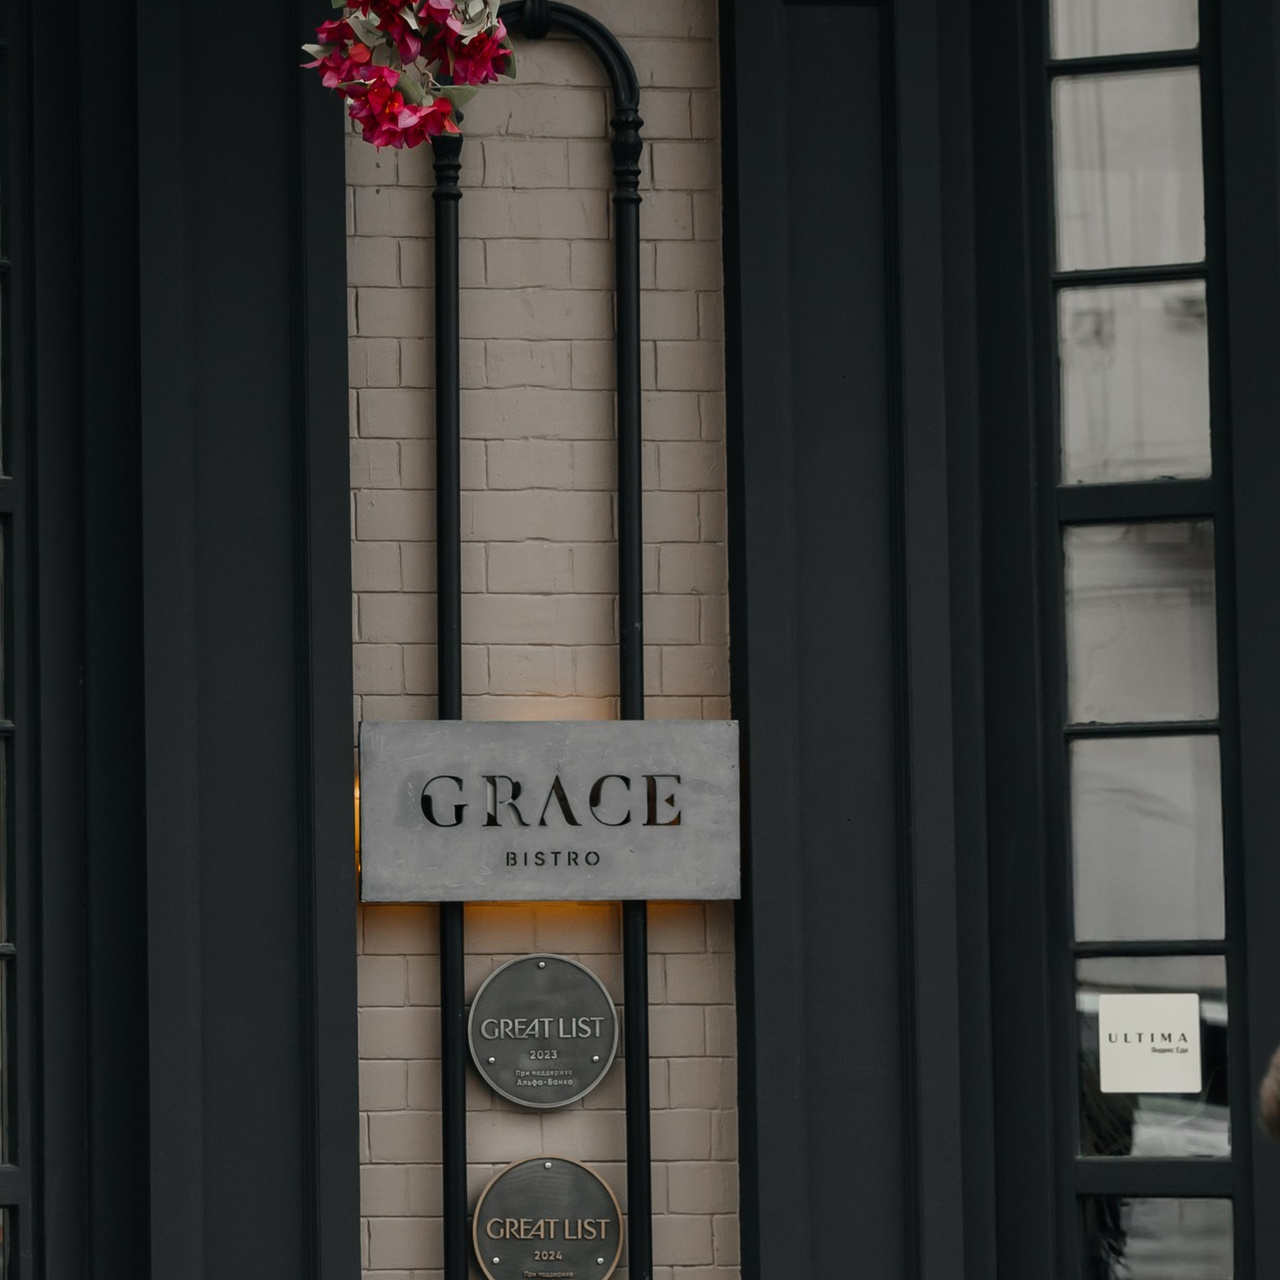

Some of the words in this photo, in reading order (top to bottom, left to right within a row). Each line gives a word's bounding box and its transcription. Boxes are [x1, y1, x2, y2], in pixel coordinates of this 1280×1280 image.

[420, 774, 683, 828] GRACE
[506, 850, 601, 867] BISTRO
[480, 1018, 554, 1039] GREAT
[559, 1017, 605, 1038] LIST
[1108, 1032, 1188, 1043] ULTIMA
[529, 1050, 558, 1060] 2023
[515, 1070, 530, 1078] При
[516, 1078, 574, 1087] Альфа-Банка
[486, 1218, 559, 1239] GREAT
[564, 1218, 611, 1239] LIST
[534, 1251, 563, 1260] 2024
